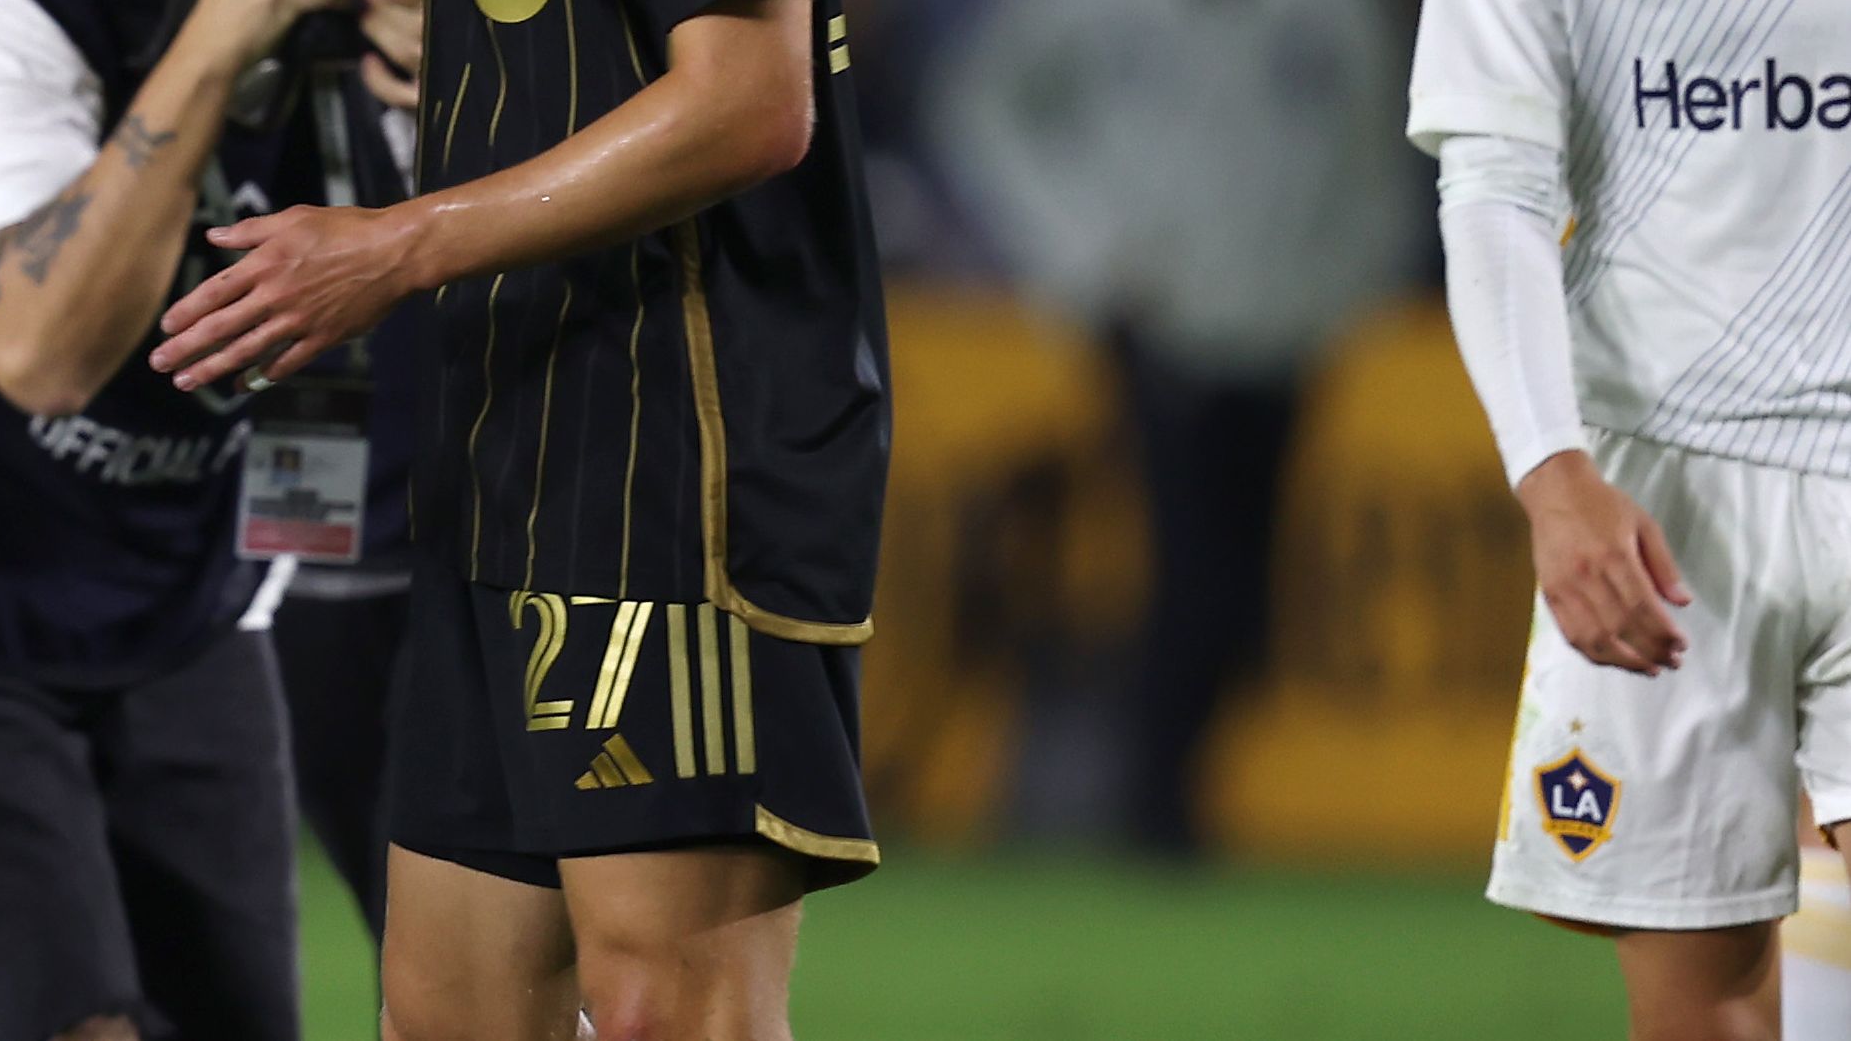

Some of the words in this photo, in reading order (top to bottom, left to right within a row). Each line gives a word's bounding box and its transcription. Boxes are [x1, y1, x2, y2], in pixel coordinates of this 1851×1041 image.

[1633, 57, 1851, 131] Herba
[509, 589, 654, 731] 27
[1552, 784, 1603, 822] LA
